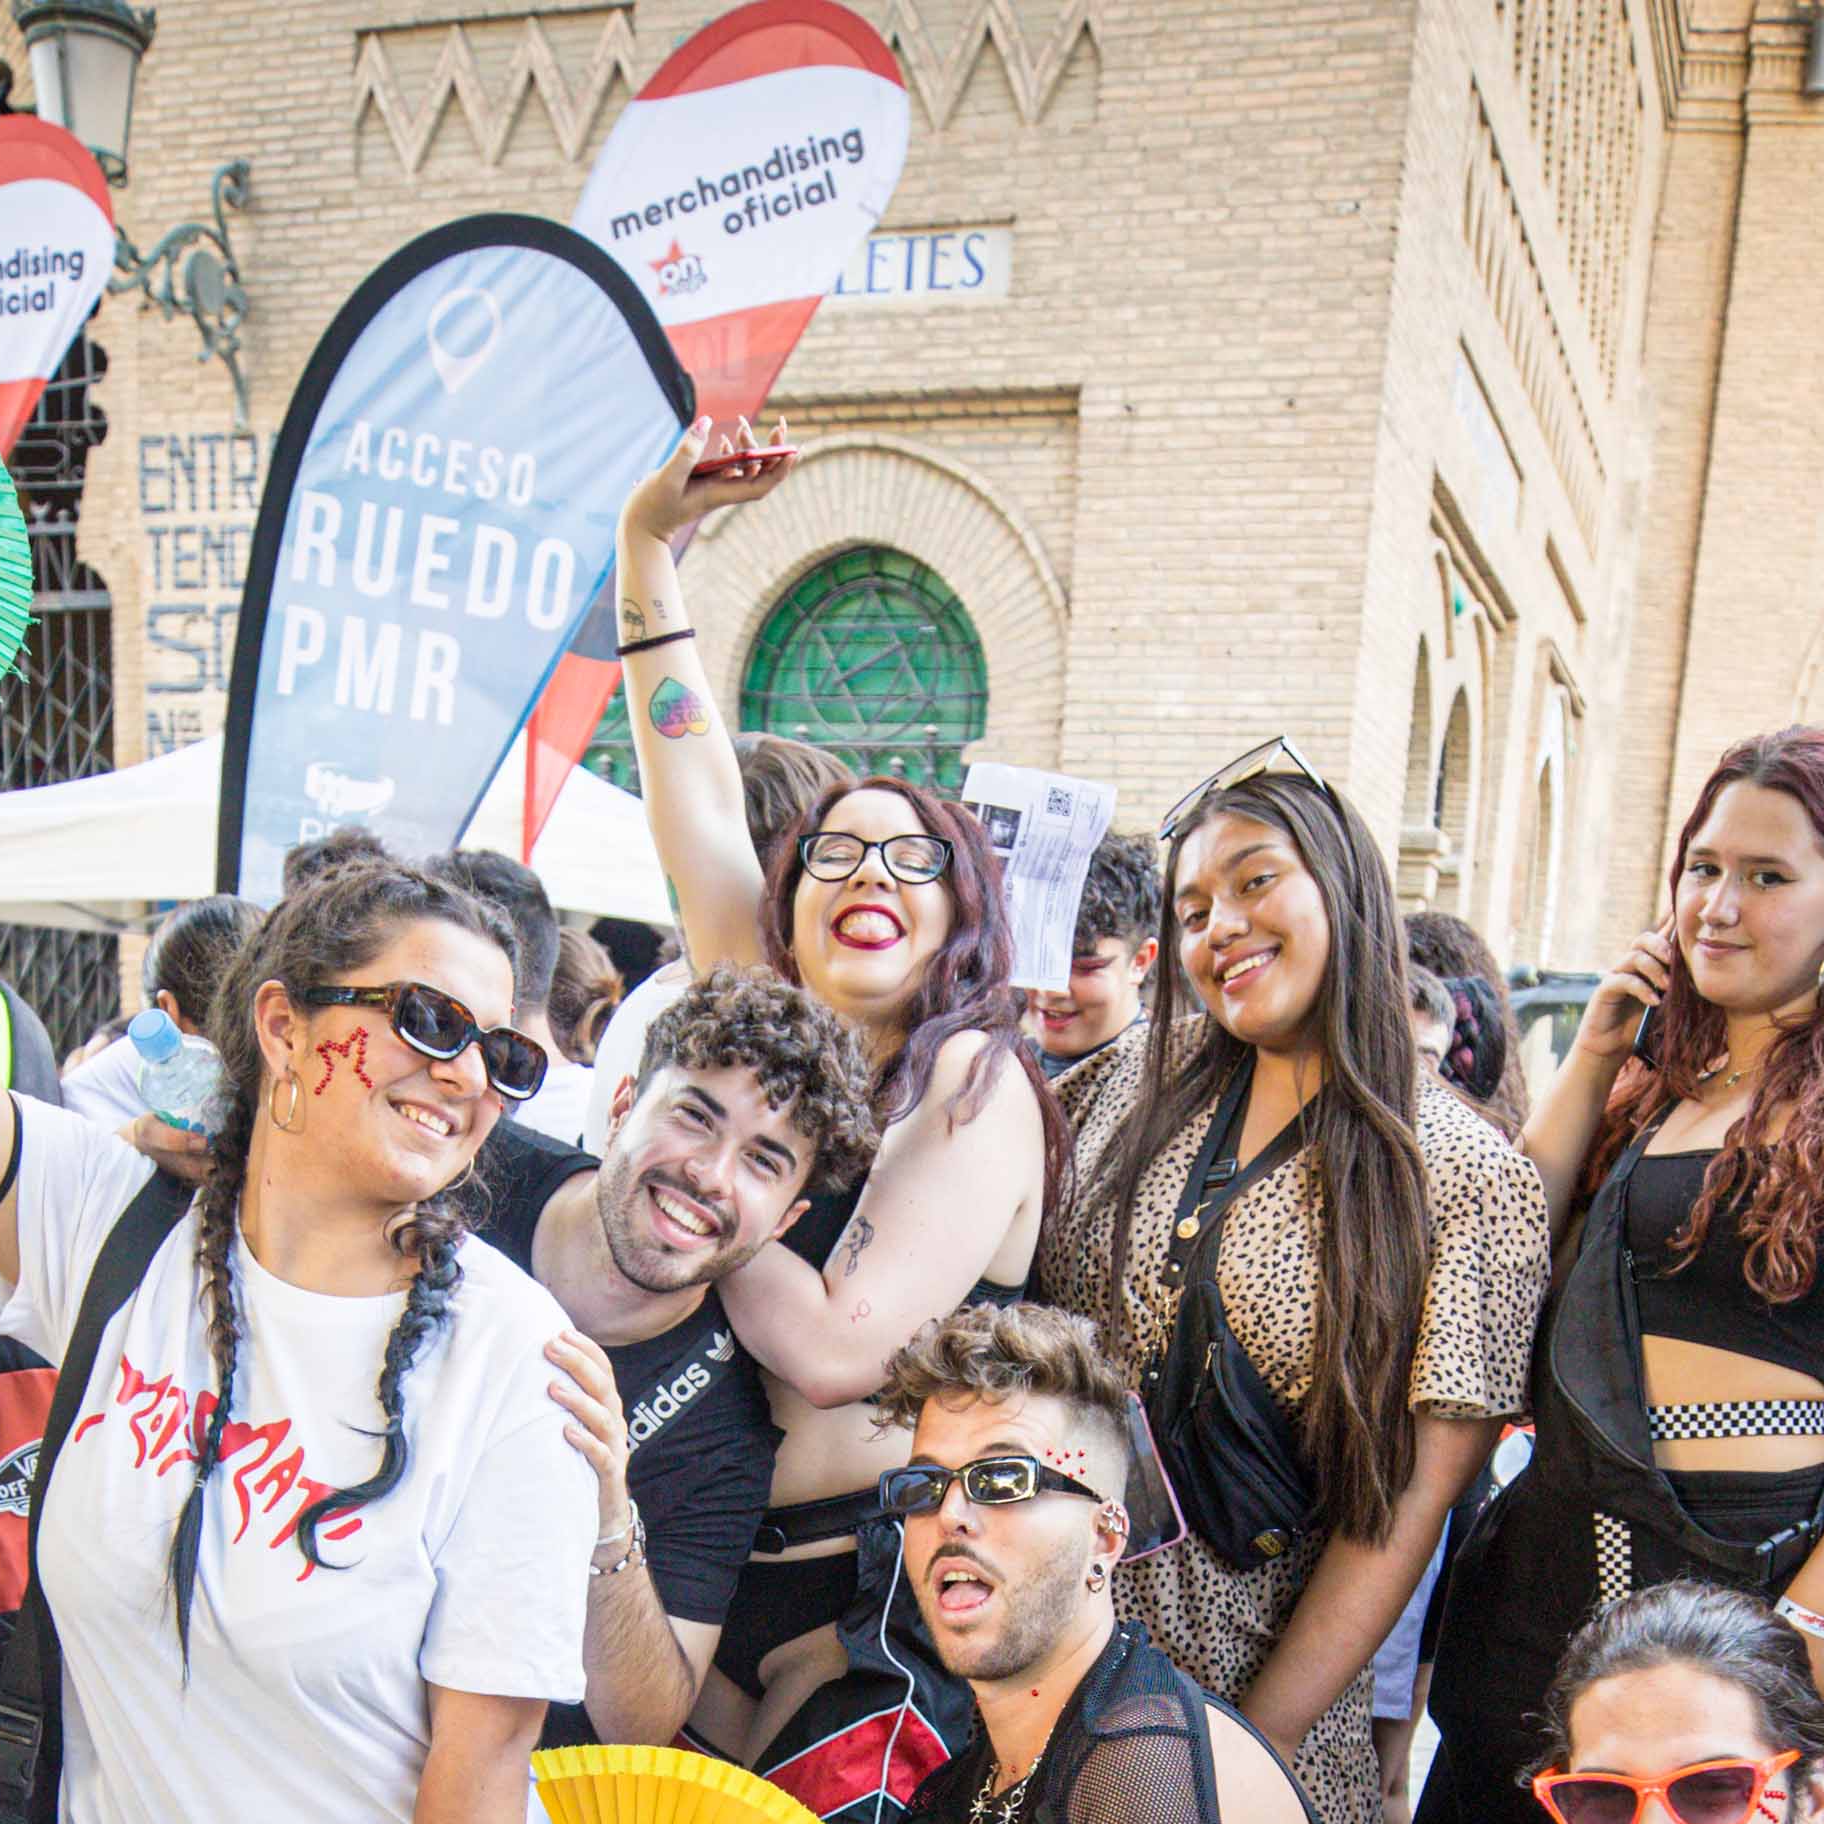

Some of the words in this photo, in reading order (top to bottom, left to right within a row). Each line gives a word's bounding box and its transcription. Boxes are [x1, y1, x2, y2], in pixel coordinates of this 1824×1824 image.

[610, 128, 865, 239] merchandising
[723, 171, 838, 235] oficial
[139, 432, 261, 512] ENTR
[343, 420, 538, 507] ACCESO
[291, 490, 576, 632] RUEDO
[276, 605, 461, 725] PMR
